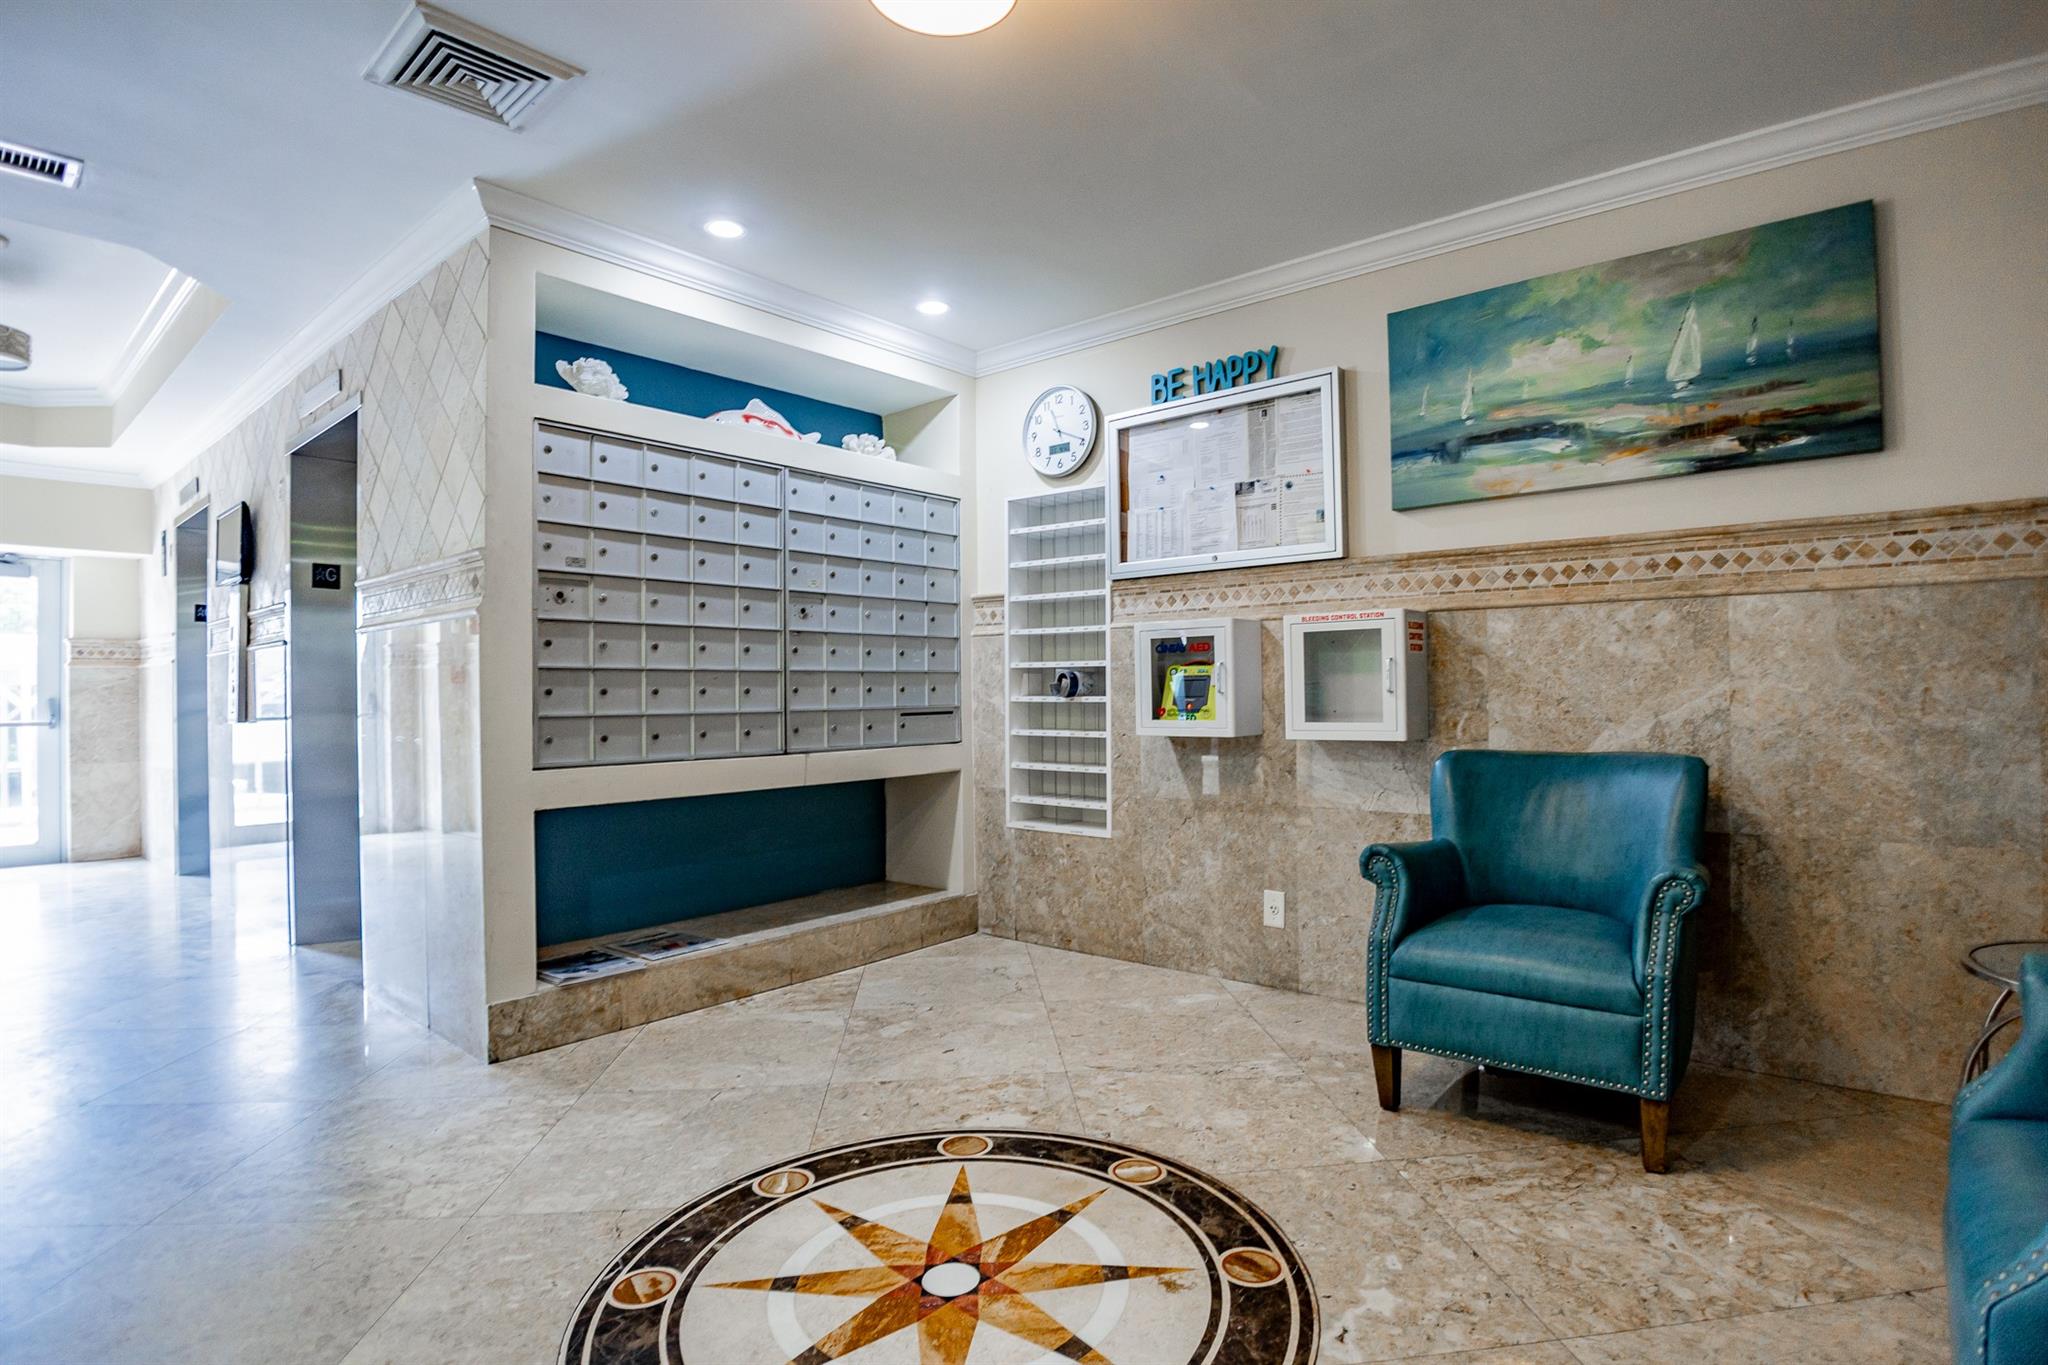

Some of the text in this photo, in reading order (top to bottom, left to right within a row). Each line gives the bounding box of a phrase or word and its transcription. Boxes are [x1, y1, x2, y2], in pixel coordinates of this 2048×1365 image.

[1151, 345, 1278, 405] BE HAPPY
[325, 567, 337, 582] G
[1301, 614, 1330, 622] BLEEDING
[1331, 612, 1358, 620] CONTROL
